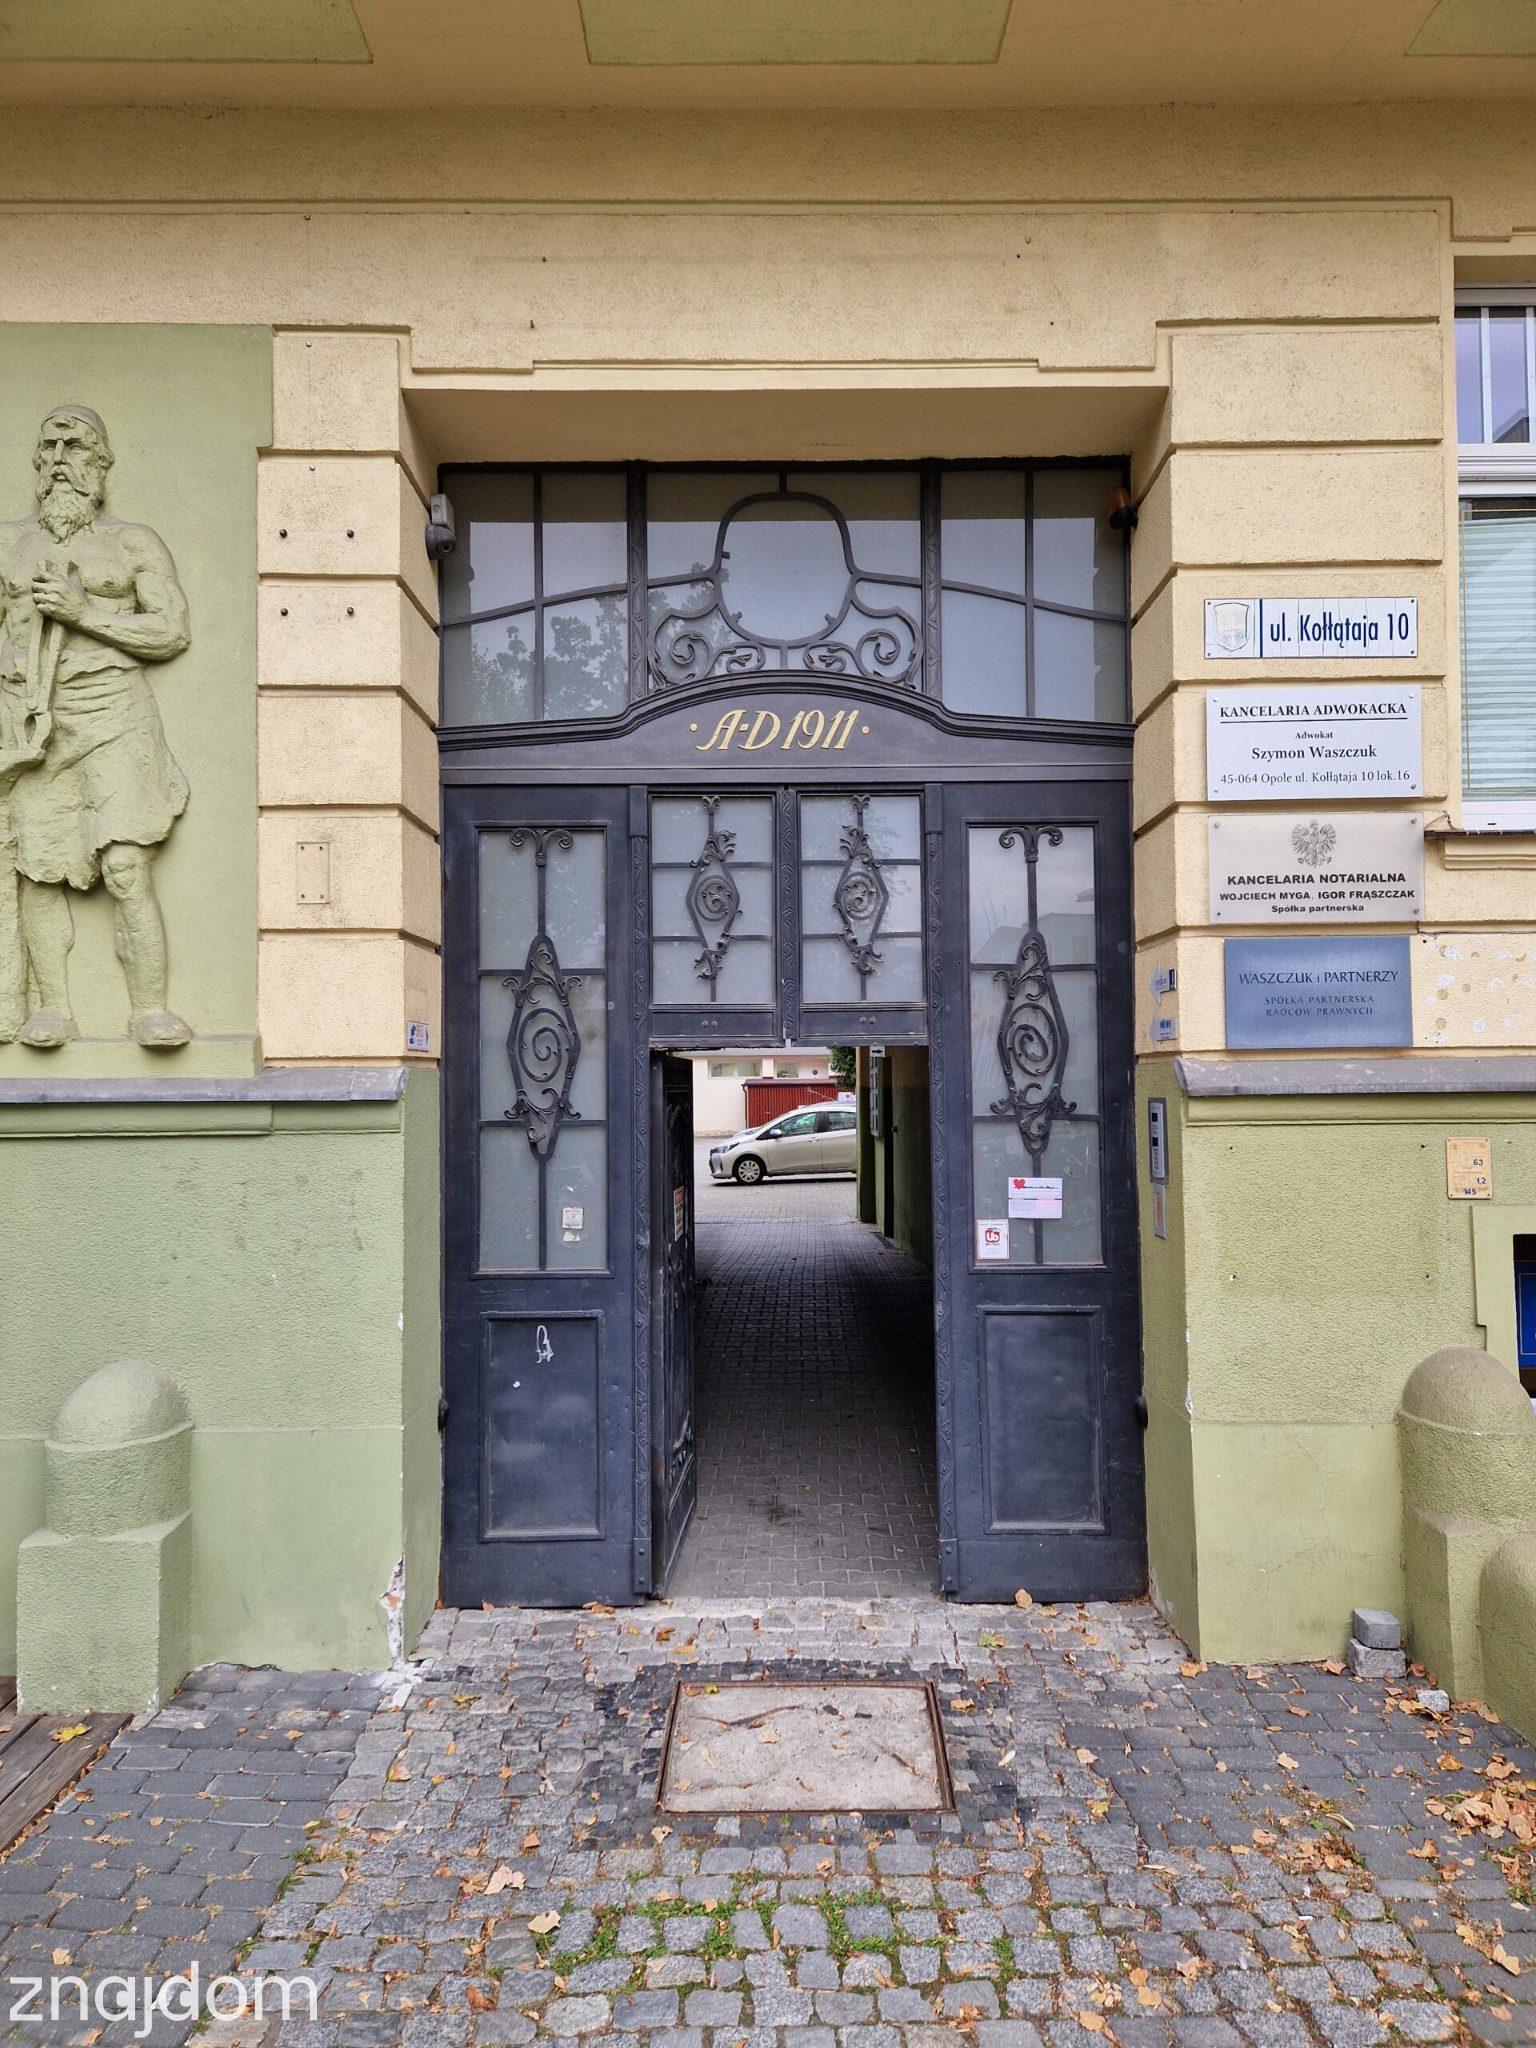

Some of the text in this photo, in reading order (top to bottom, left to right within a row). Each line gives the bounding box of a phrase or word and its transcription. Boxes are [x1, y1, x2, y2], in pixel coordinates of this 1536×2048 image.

[1270, 611, 1409, 648] ul. Kołłątaja 10
[1220, 702, 1407, 718] KANCELARIA ADWOKACKA
[779, 709, 860, 750] 1911
[1295, 731, 1334, 740] Adwokat
[1251, 744, 1377, 763] Szymon Waszczuk
[1220, 773, 1258, 784] 45-064
[1261, 772, 1293, 786] Opole
[1295, 771, 1308, 783] ul.
[1312, 771, 1358, 784] Kołłątaja
[1361, 771, 1375, 782] 10
[1227, 872, 1407, 886] KANCELARIA NOTARIALNA
[1219, 892, 1277, 901] WOJCIECH
[1317, 890, 1346, 900] IGOR
[1349, 889, 1415, 901] FRĄSZCZAK
[1308, 903, 1365, 914] partnerska
[1238, 972, 1313, 985] WASZCZUK
[1324, 970, 1399, 983] PARTNERZY
[1308, 994, 1374, 1005] PARTNERSKA
[1316, 1006, 1373, 1017] PRAWNYCH
